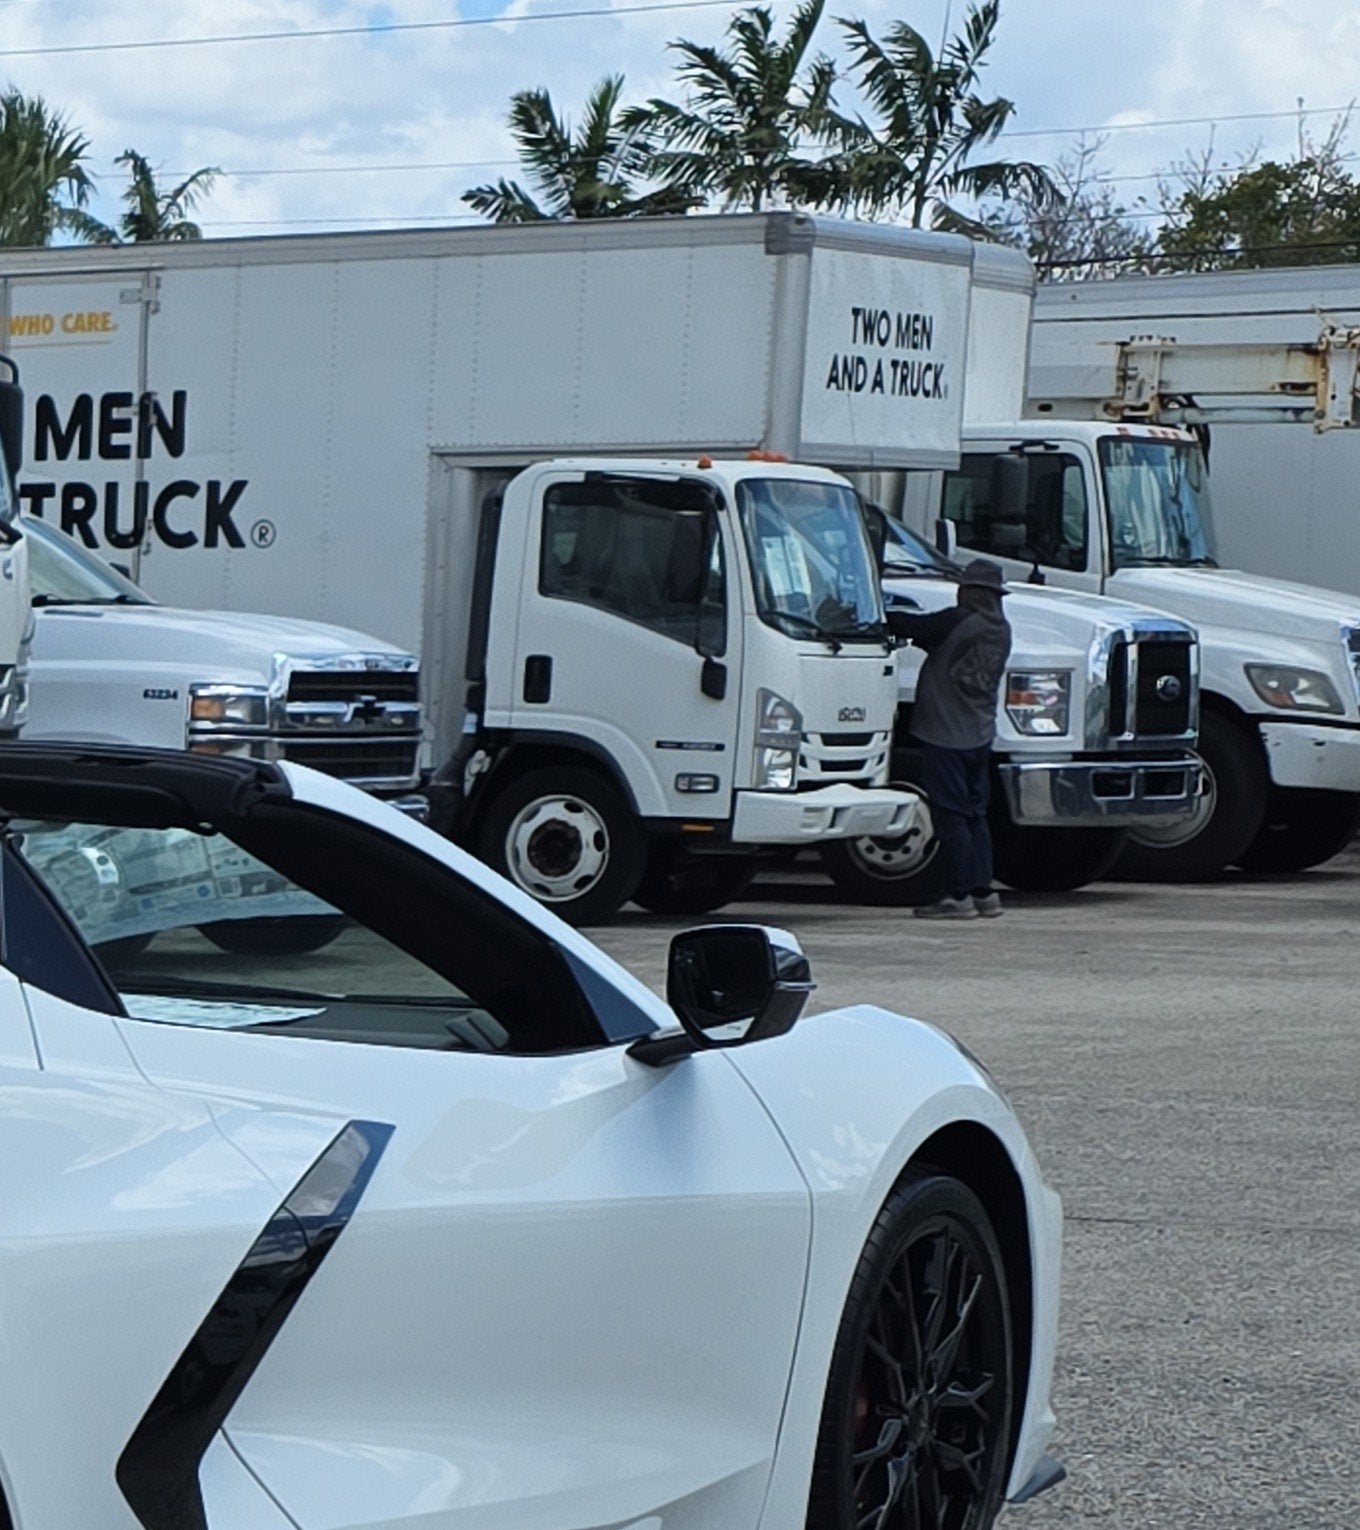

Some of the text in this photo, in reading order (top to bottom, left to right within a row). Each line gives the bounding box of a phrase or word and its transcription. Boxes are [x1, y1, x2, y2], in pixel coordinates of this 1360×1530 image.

[9, 313, 54, 336] WHO
[61, 311, 119, 334] CARE.
[851, 307, 933, 351] TWO MEN
[826, 353, 945, 399] AND A TRUCK
[34, 390, 187, 461] MEN
[19, 480, 248, 549] TRUCK
